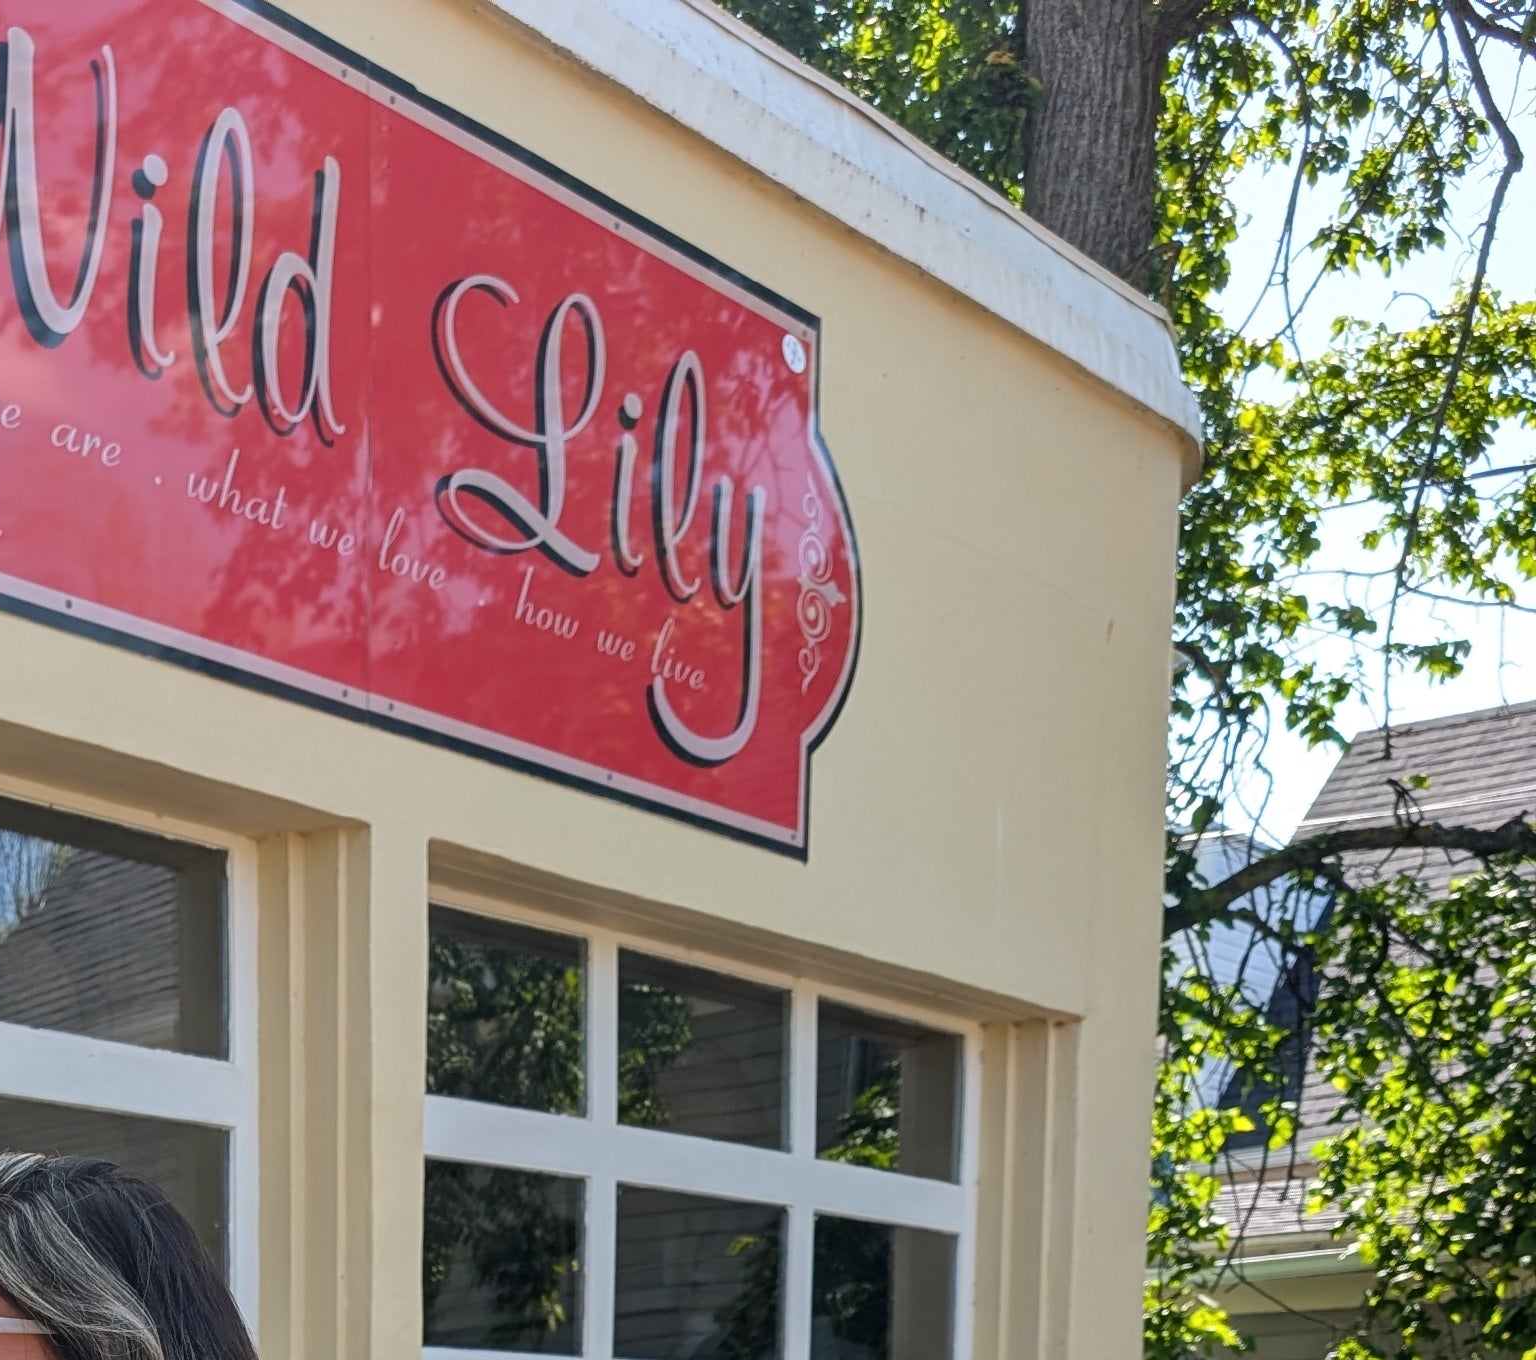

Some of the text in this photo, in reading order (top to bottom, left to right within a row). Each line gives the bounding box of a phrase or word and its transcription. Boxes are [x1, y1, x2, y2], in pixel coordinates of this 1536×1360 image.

[50, 423, 122, 468] are
[185, 448, 289, 530] what
[308, 517, 355, 556] we
[378, 506, 447, 590] love
[514, 566, 580, 641] how
[596, 629, 636, 663] we
[650, 616, 707, 691] live
[432, 275, 766, 766] Lily
